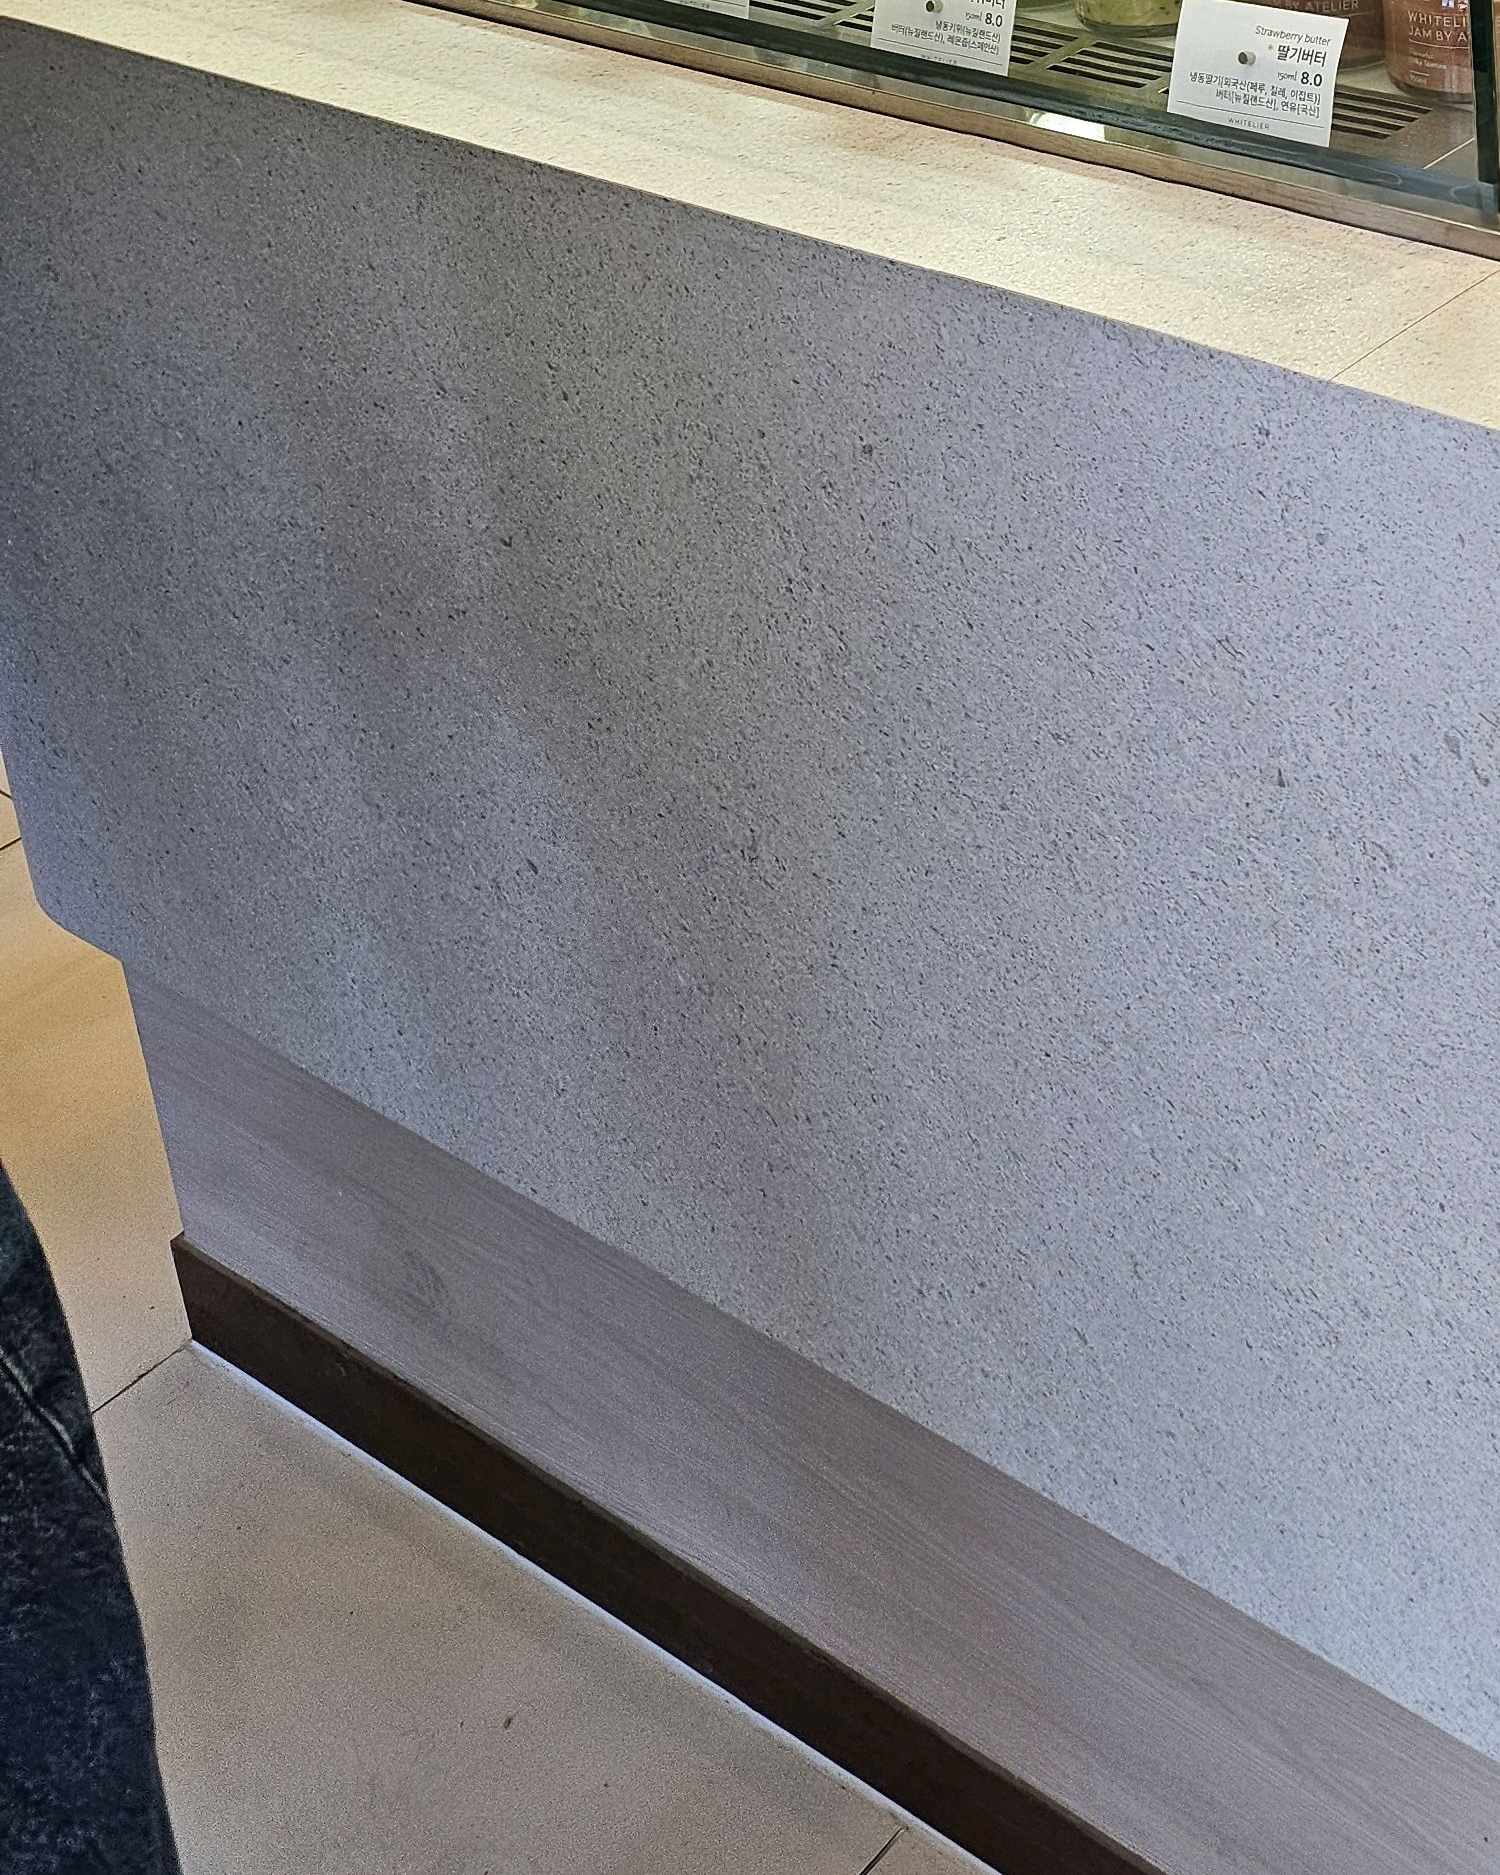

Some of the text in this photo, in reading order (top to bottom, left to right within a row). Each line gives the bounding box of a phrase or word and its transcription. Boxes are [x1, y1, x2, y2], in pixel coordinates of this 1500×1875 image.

[984, 11, 1004, 29] 8.0
[1254, 25, 1332, 47] Strawberry butter
[1408, 25, 1432, 39] JAM
[1436, 29, 1452, 43] BY
[1276, 43, 1328, 69] 딸기버터
[1300, 71, 1324, 87] 8.0
[1228, 117, 1270, 131] WHITELIER
